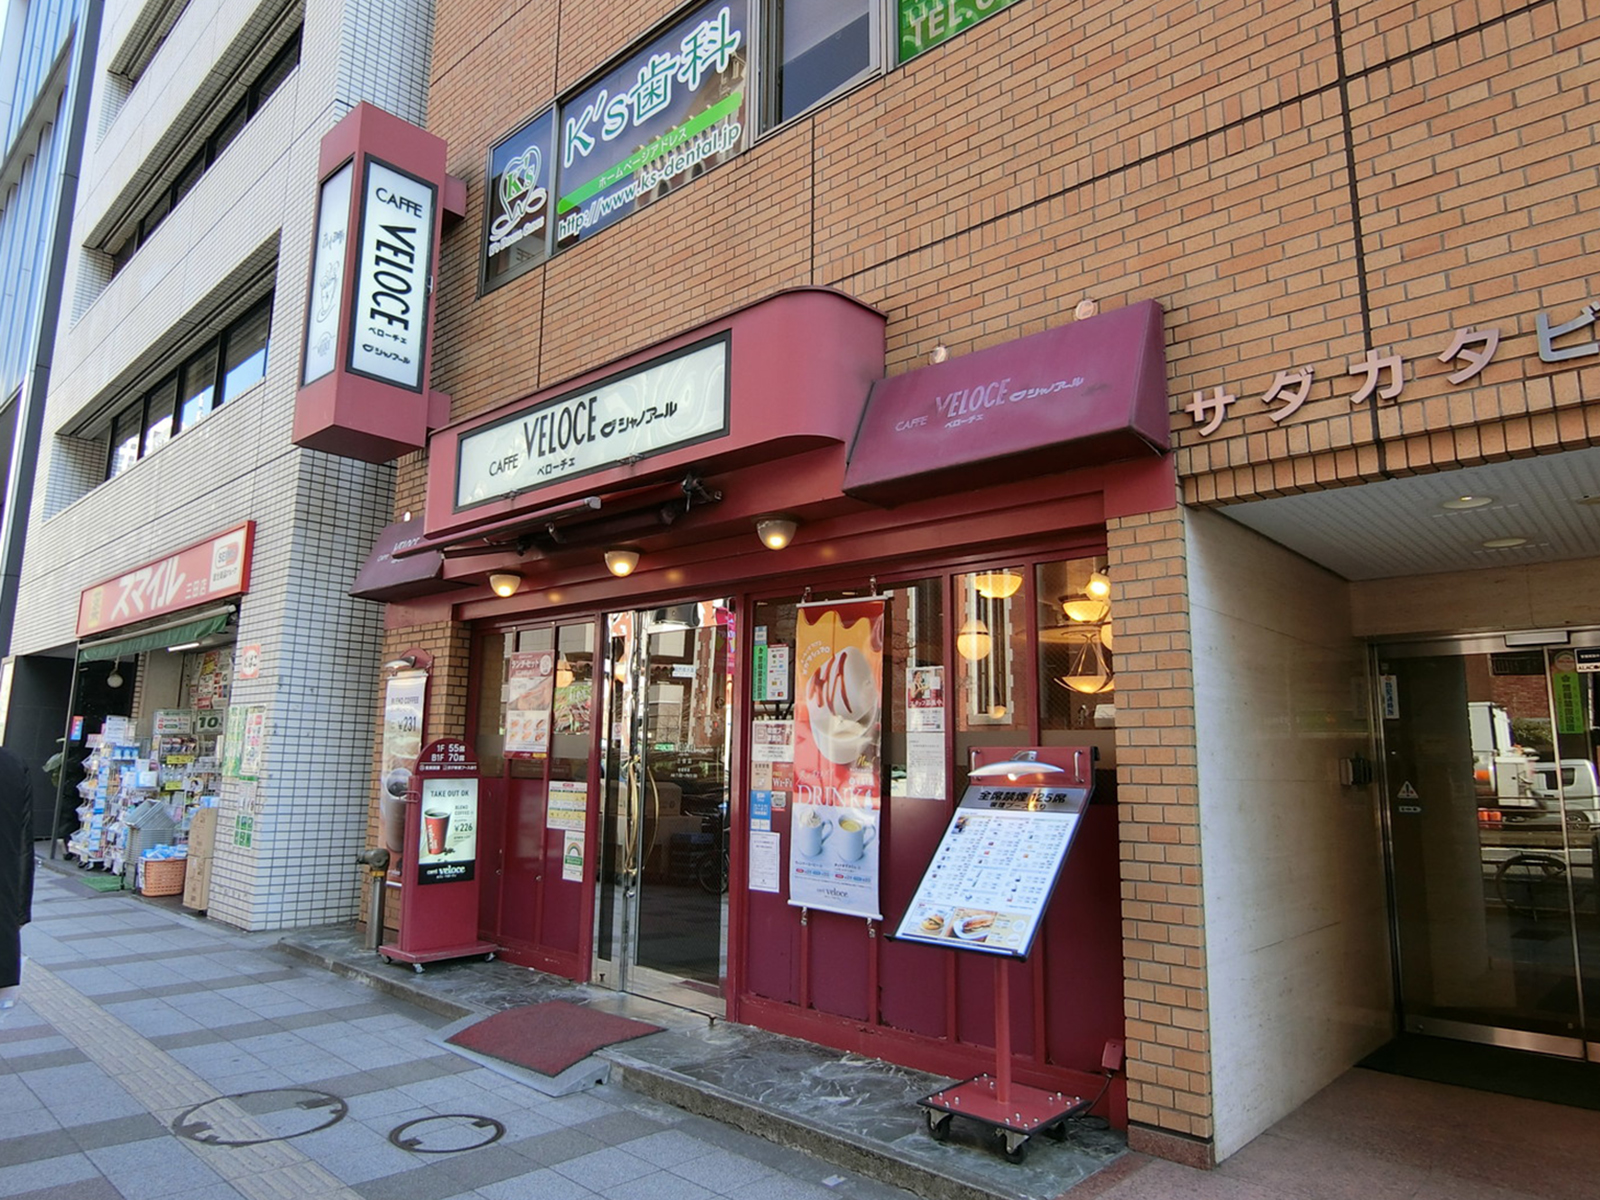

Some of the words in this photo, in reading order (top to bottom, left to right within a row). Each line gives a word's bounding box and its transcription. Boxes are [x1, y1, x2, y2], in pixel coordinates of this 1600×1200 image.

[598, 127, 688, 188] ホームページアドレス
[506, 153, 537, 201] K's
[557, 123, 742, 242] http://www.ks-dental.jp
[375, 187, 423, 219] CAFFE
[369, 223, 417, 331] VELOCE
[368, 327, 407, 344] ベローチェ
[1184, 300, 1600, 437] サダカタビ
[895, 415, 929, 432] CAFFE
[935, 378, 1011, 419] VELOCE
[944, 414, 985, 429] ベローチェ
[489, 453, 519, 477] CAFFE
[523, 396, 598, 460] VELOCE
[536, 456, 576, 476] ベローチェ
[111, 557, 186, 621] スマイル
[431, 753, 445, 762] B1F
[436, 744, 445, 753] 1F
[772, 777, 793, 788] Wi-Fi
[978, 790, 1029, 802] 全席禁煙
[1030, 792, 1068, 804] 125席
[438, 865, 466, 875] veloce
[826, 887, 849, 899] veloce
